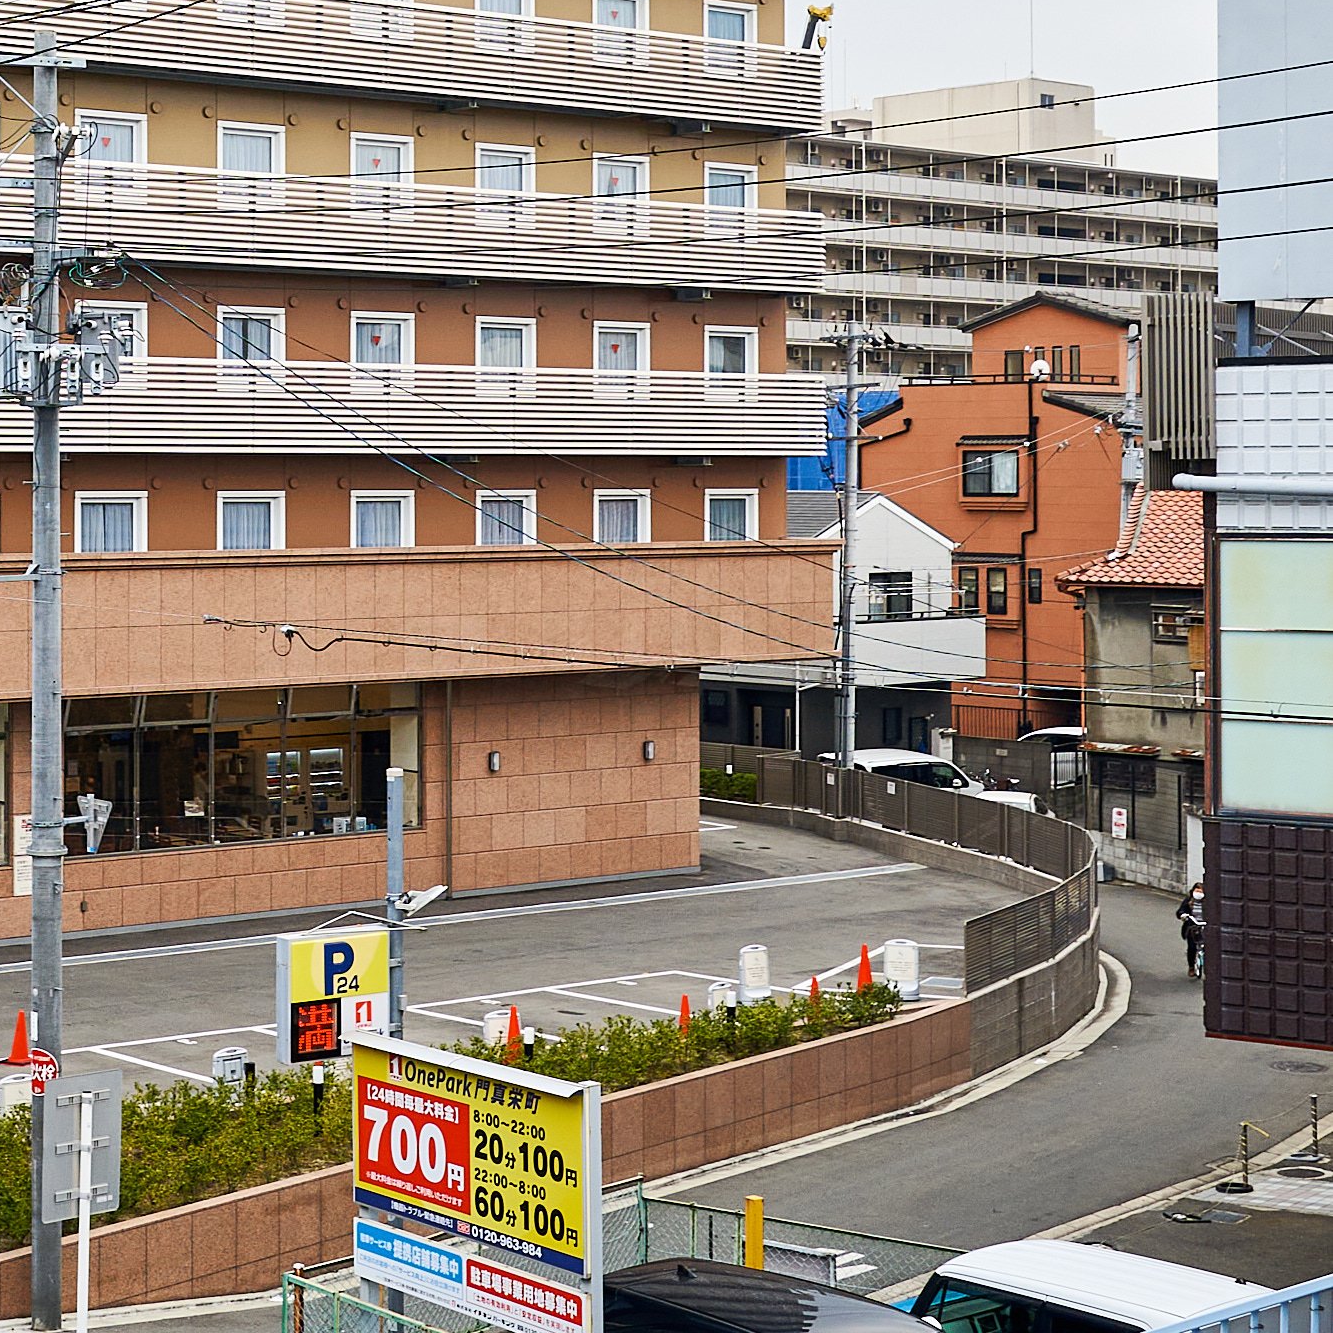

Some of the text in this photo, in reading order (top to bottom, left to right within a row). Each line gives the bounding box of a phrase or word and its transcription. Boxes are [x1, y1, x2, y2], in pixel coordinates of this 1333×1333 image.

[323, 941, 355, 997] P
[336, 974, 360, 994] 24
[31, 1063, 57, 1082] 火栓
[404, 1059, 472, 1098] OnePark
[473, 1078, 542, 1115] 門真栄町
[363, 1104, 465, 1192] 700円
[471, 1225, 543, 1259] 0120-963-984
